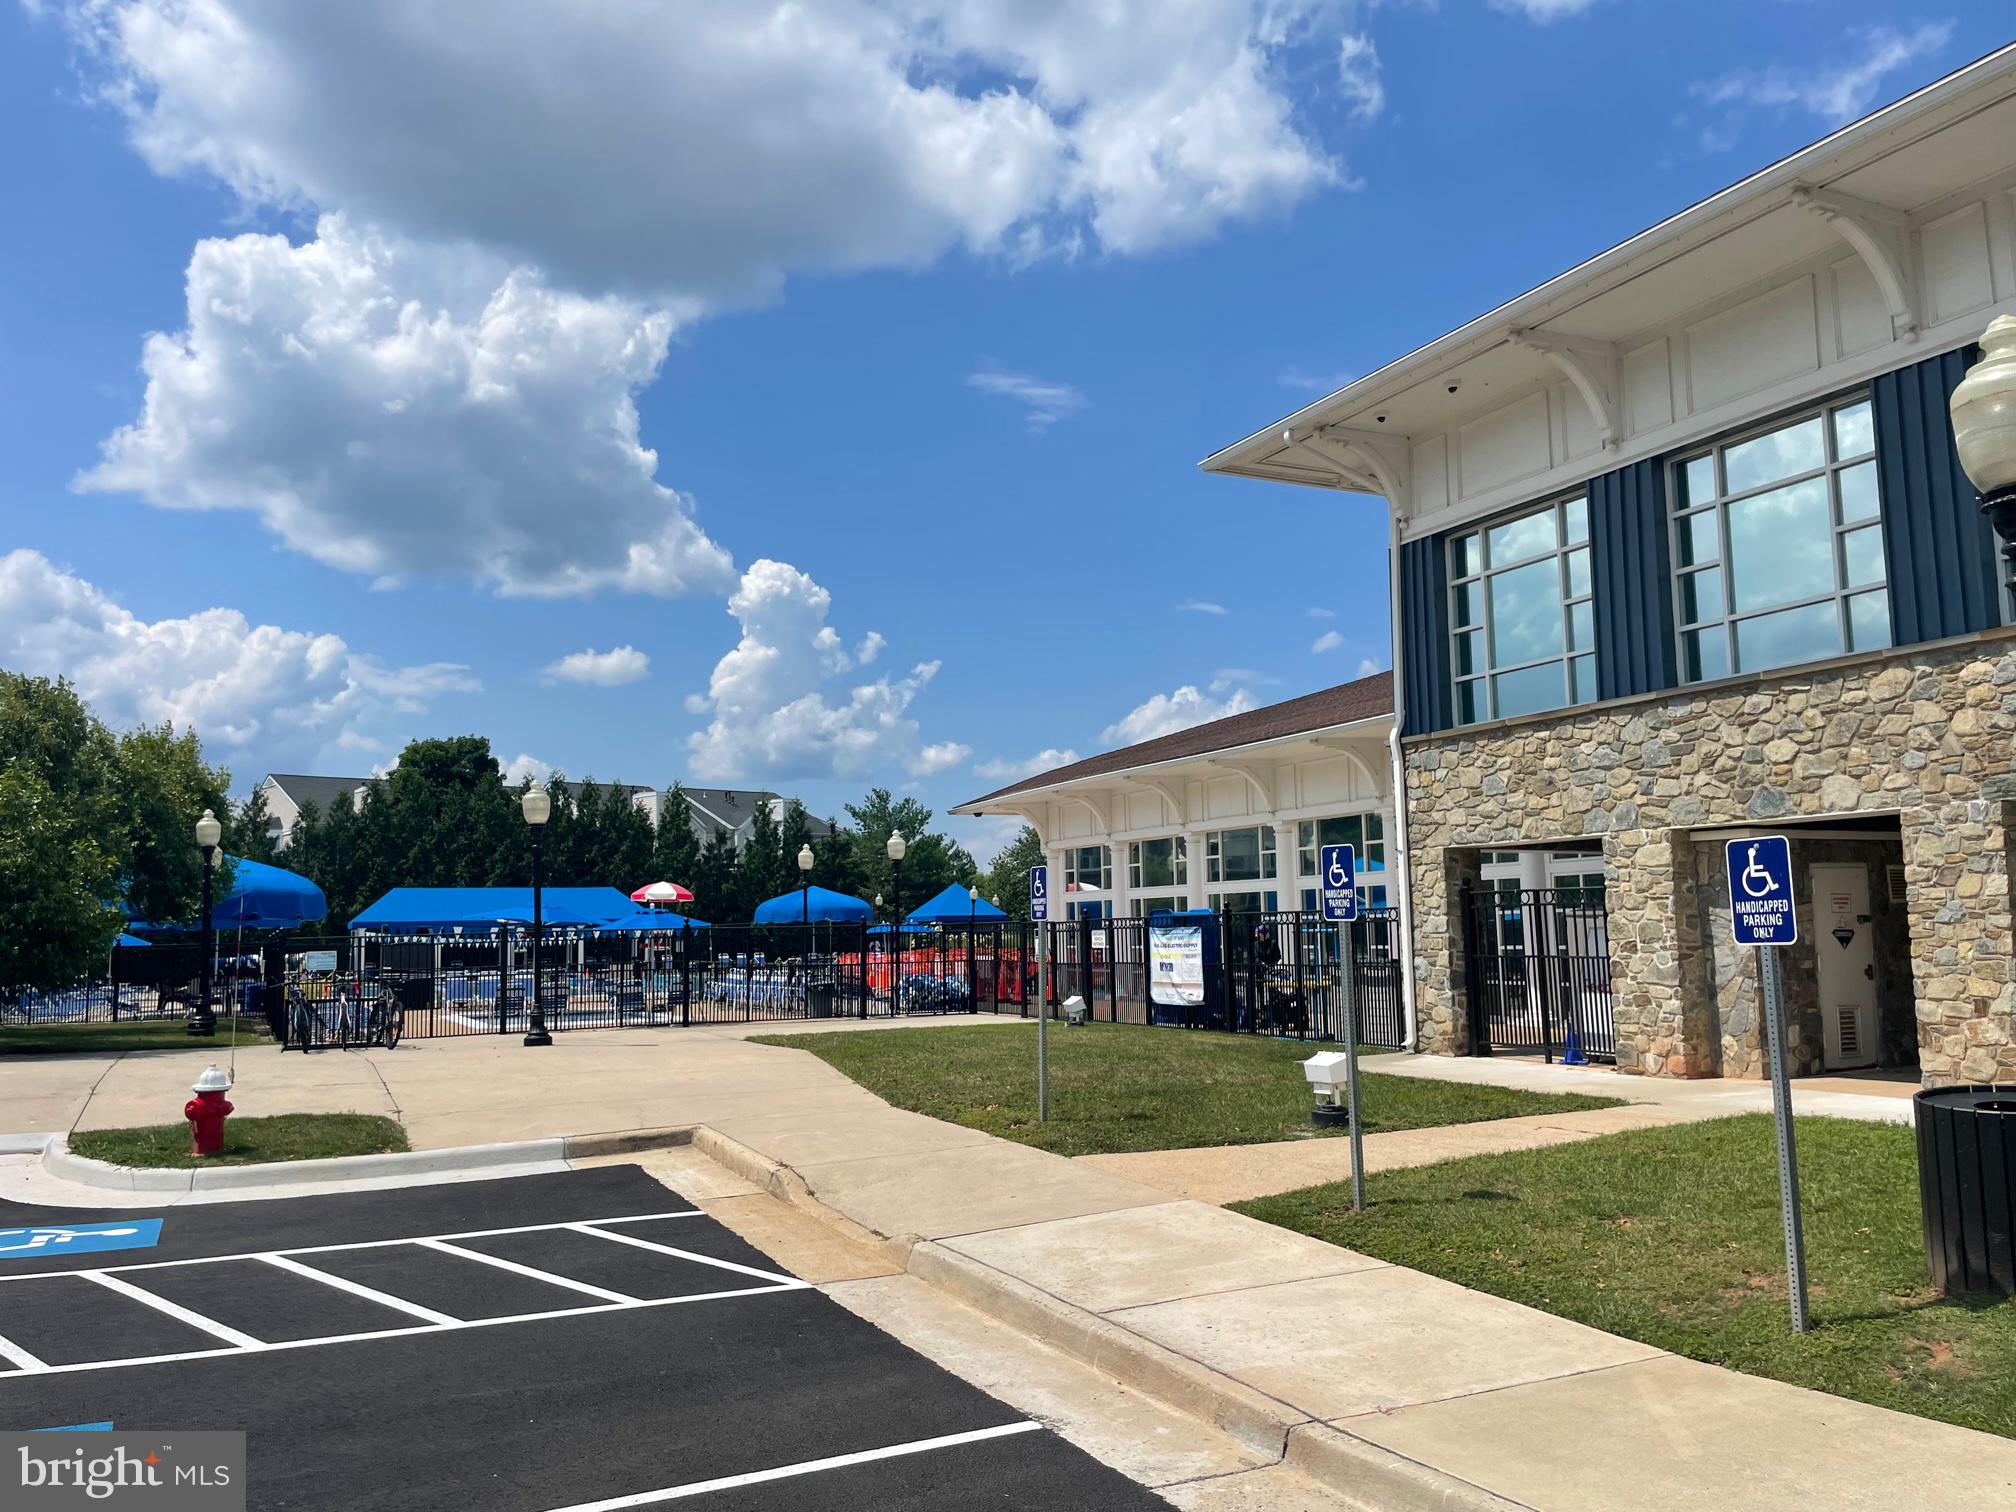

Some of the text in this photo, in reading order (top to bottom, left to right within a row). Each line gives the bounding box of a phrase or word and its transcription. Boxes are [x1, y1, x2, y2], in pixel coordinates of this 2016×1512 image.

[1328, 898, 1350, 908] PARKING
[1735, 899, 1789, 914] HANDICAPPED
[1743, 913, 1783, 927] PARKING
[1753, 926, 1775, 938] ONLY
